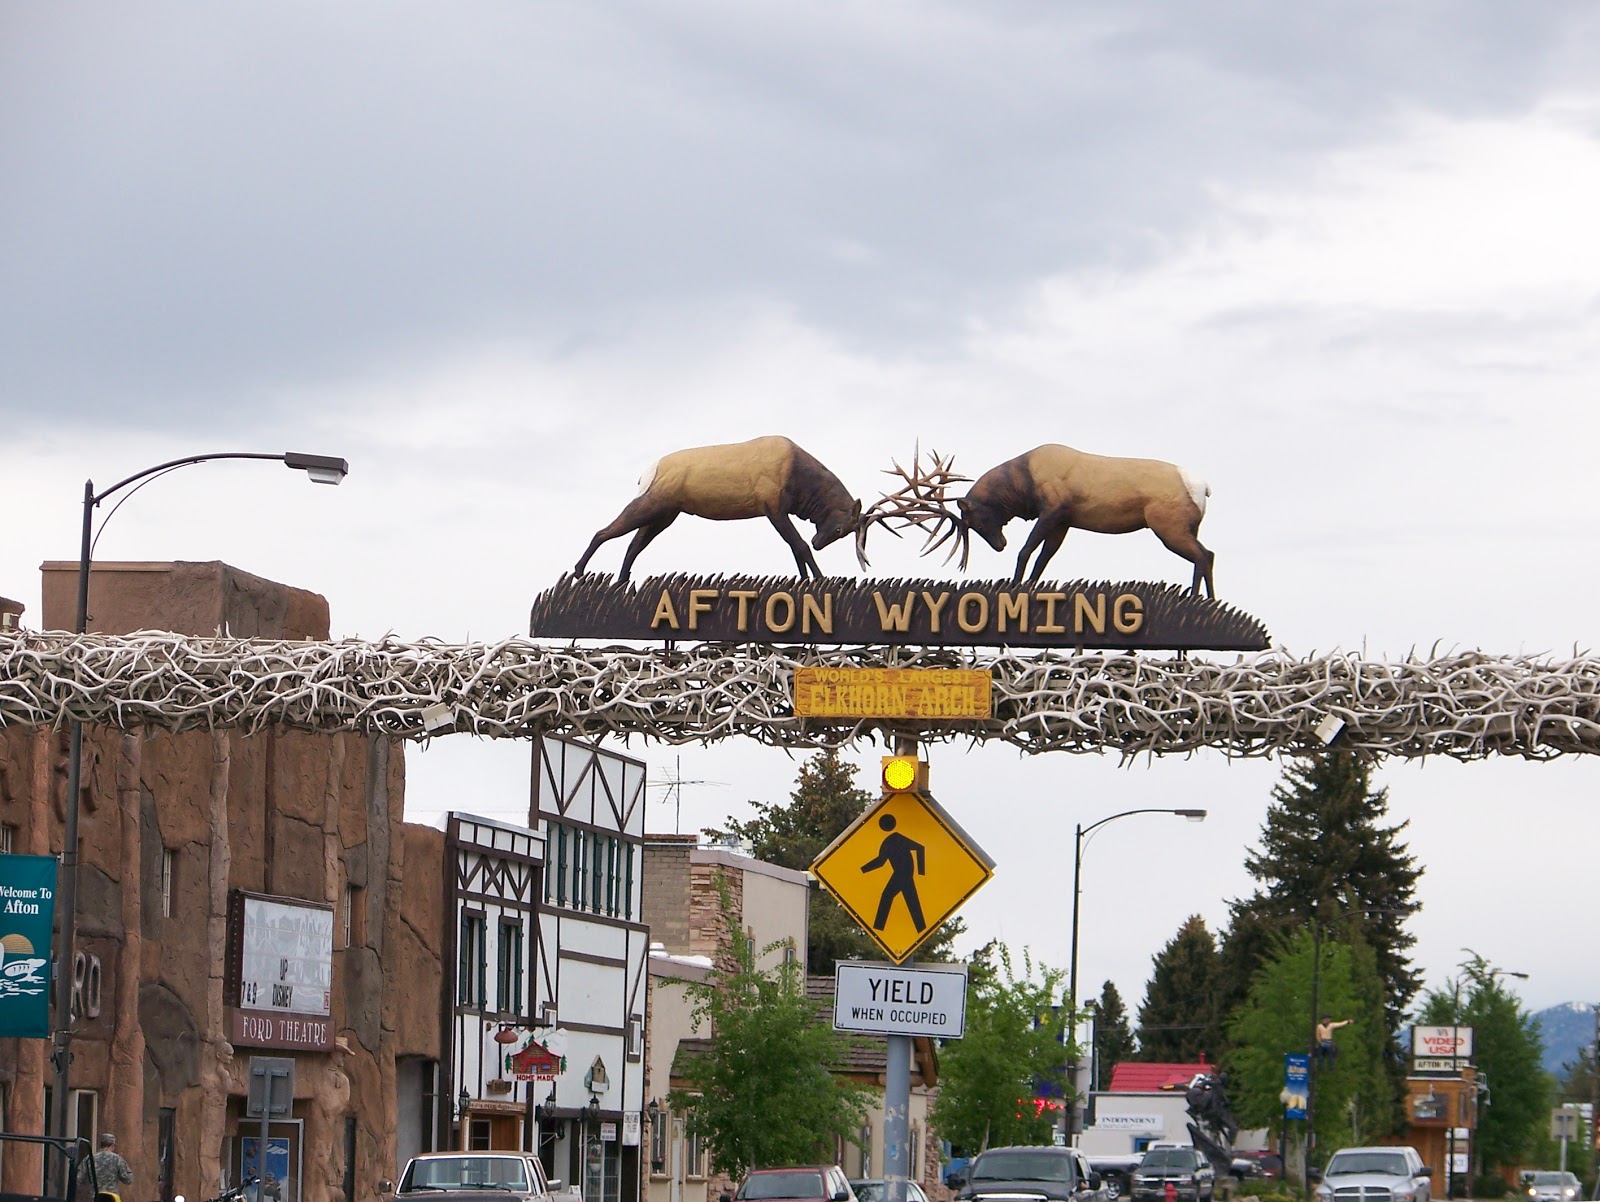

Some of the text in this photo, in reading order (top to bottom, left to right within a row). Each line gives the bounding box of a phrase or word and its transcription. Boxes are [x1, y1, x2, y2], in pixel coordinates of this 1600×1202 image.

[650, 589, 1144, 635] AFTON WYOMING
[814, 670, 972, 684] WORLD'S LARGEST
[810, 685, 976, 716] ELKHORN ARCH
[39, 887, 52, 899] To
[3, 899, 39, 915] Afton
[272, 983, 293, 1008] DISNEY
[868, 978, 933, 1005] YIELD
[851, 1007, 947, 1025] WHEN OCCUPIED
[243, 1016, 327, 1046] FORD THEATRE
[1423, 1037, 1465, 1046] VIDEO
